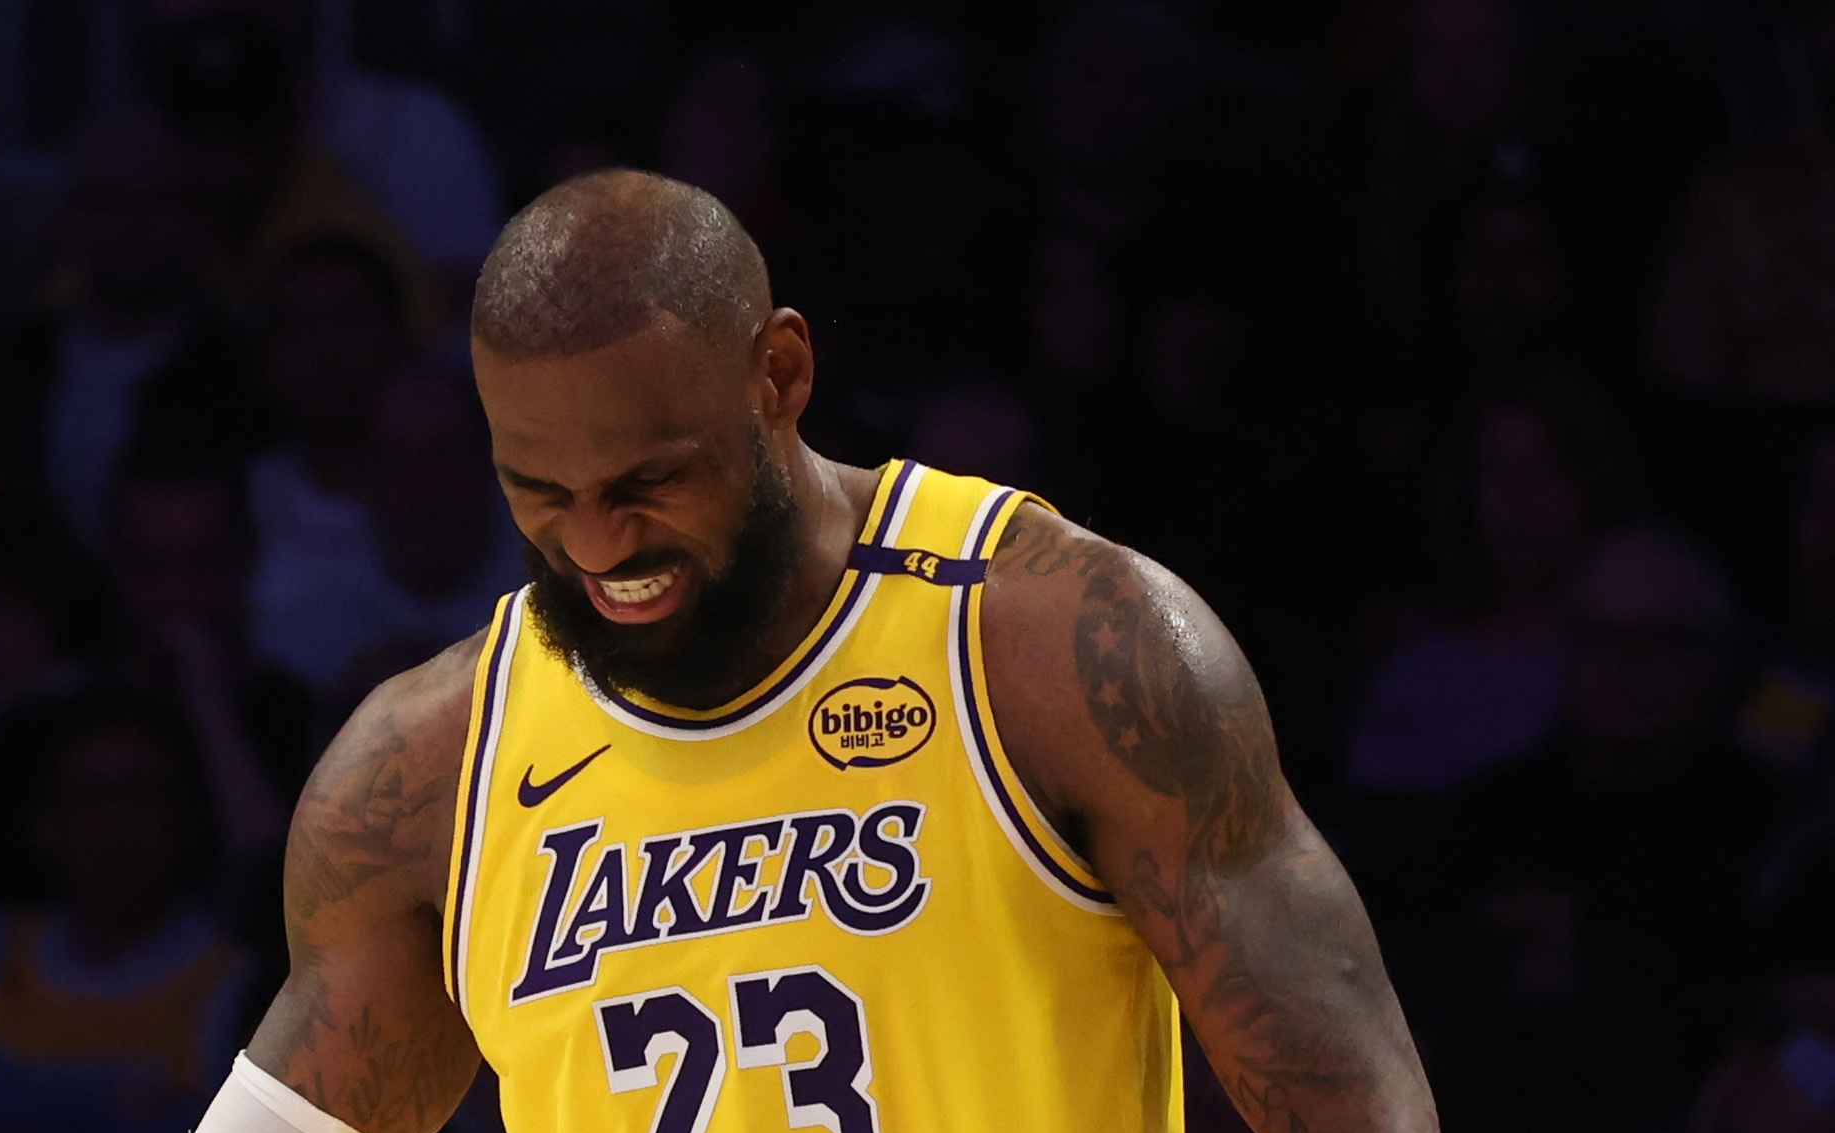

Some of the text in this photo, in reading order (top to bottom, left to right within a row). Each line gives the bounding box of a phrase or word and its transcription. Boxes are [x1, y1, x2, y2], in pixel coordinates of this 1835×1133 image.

[903, 551, 940, 579] 44
[821, 700, 928, 739] bibigo
[840, 733, 885, 750] 비비고
[509, 801, 931, 1007] LAKERS
